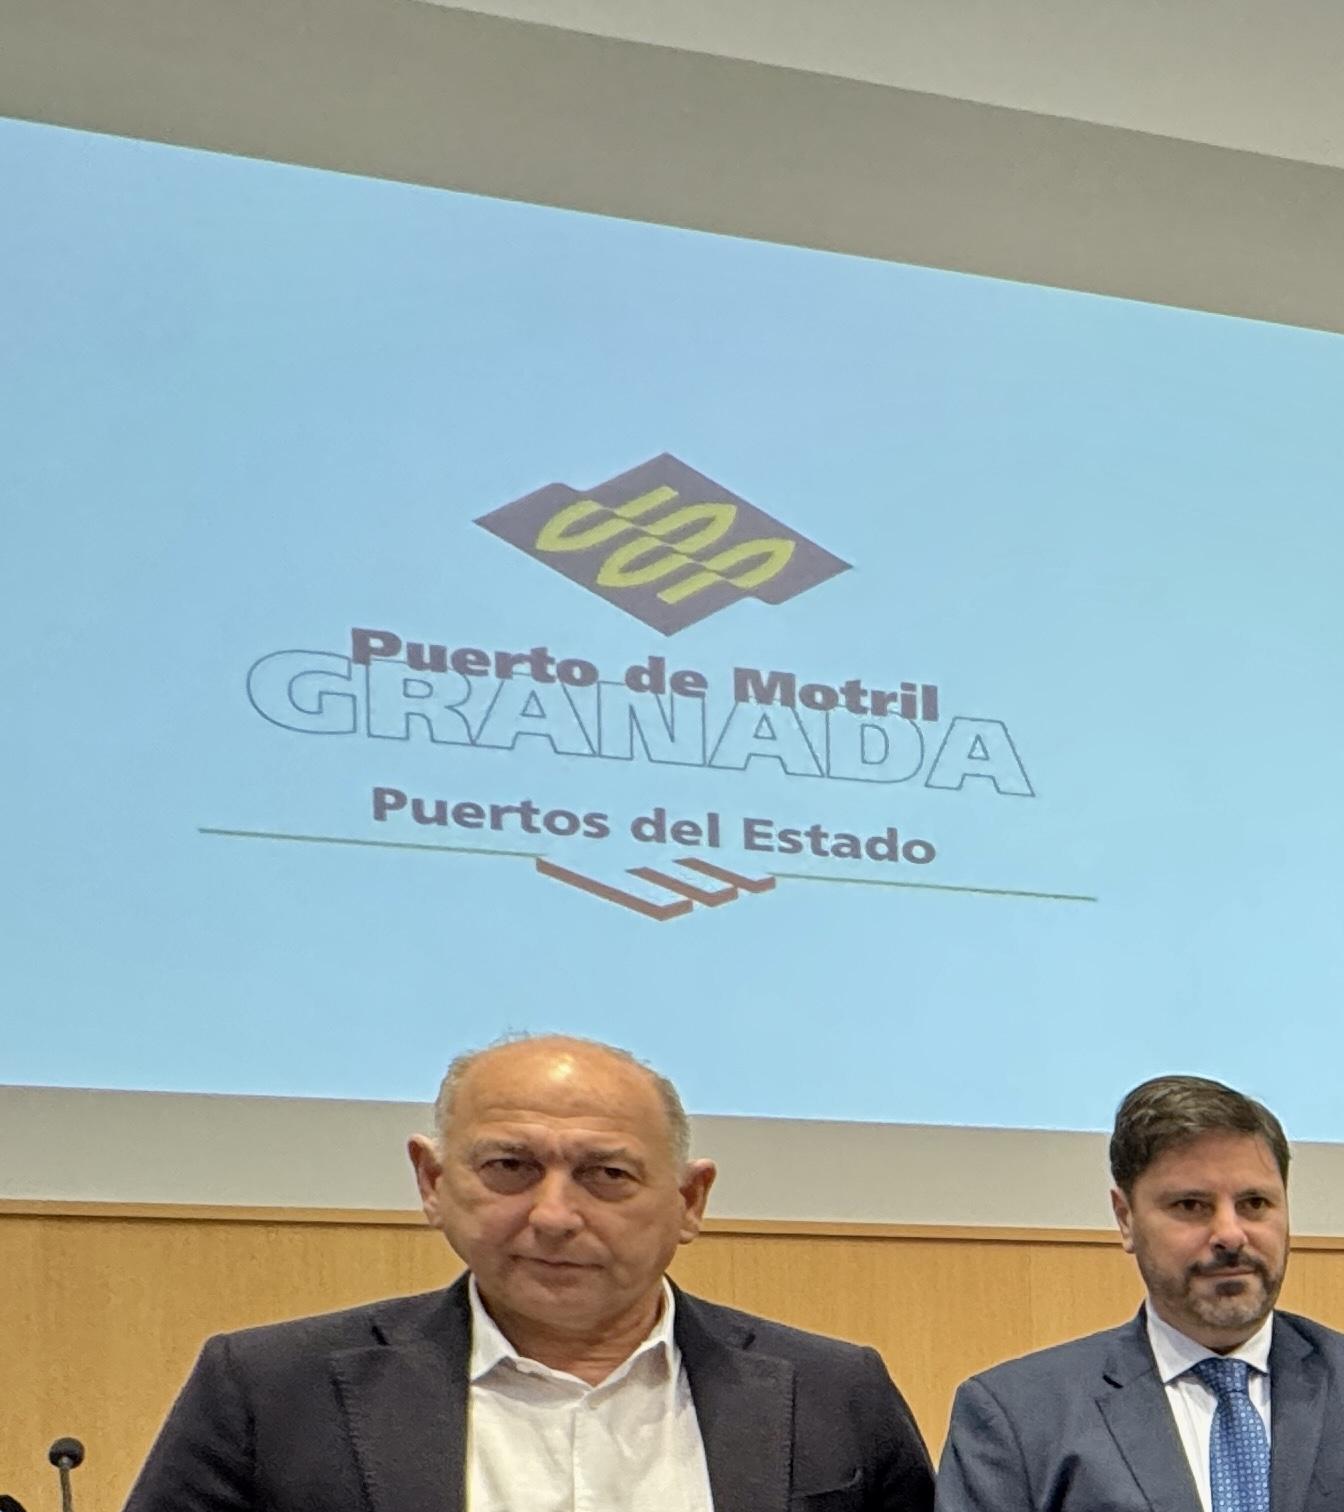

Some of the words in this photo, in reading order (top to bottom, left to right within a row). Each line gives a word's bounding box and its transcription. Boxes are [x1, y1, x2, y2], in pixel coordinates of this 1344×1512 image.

[351, 628, 599, 687] Puerto
[625, 656, 708, 699] de
[733, 667, 939, 722] Motril
[245, 649, 1035, 797] GRANADA
[372, 786, 609, 840] Puertos
[631, 806, 720, 848] del
[744, 817, 937, 865] Estado
